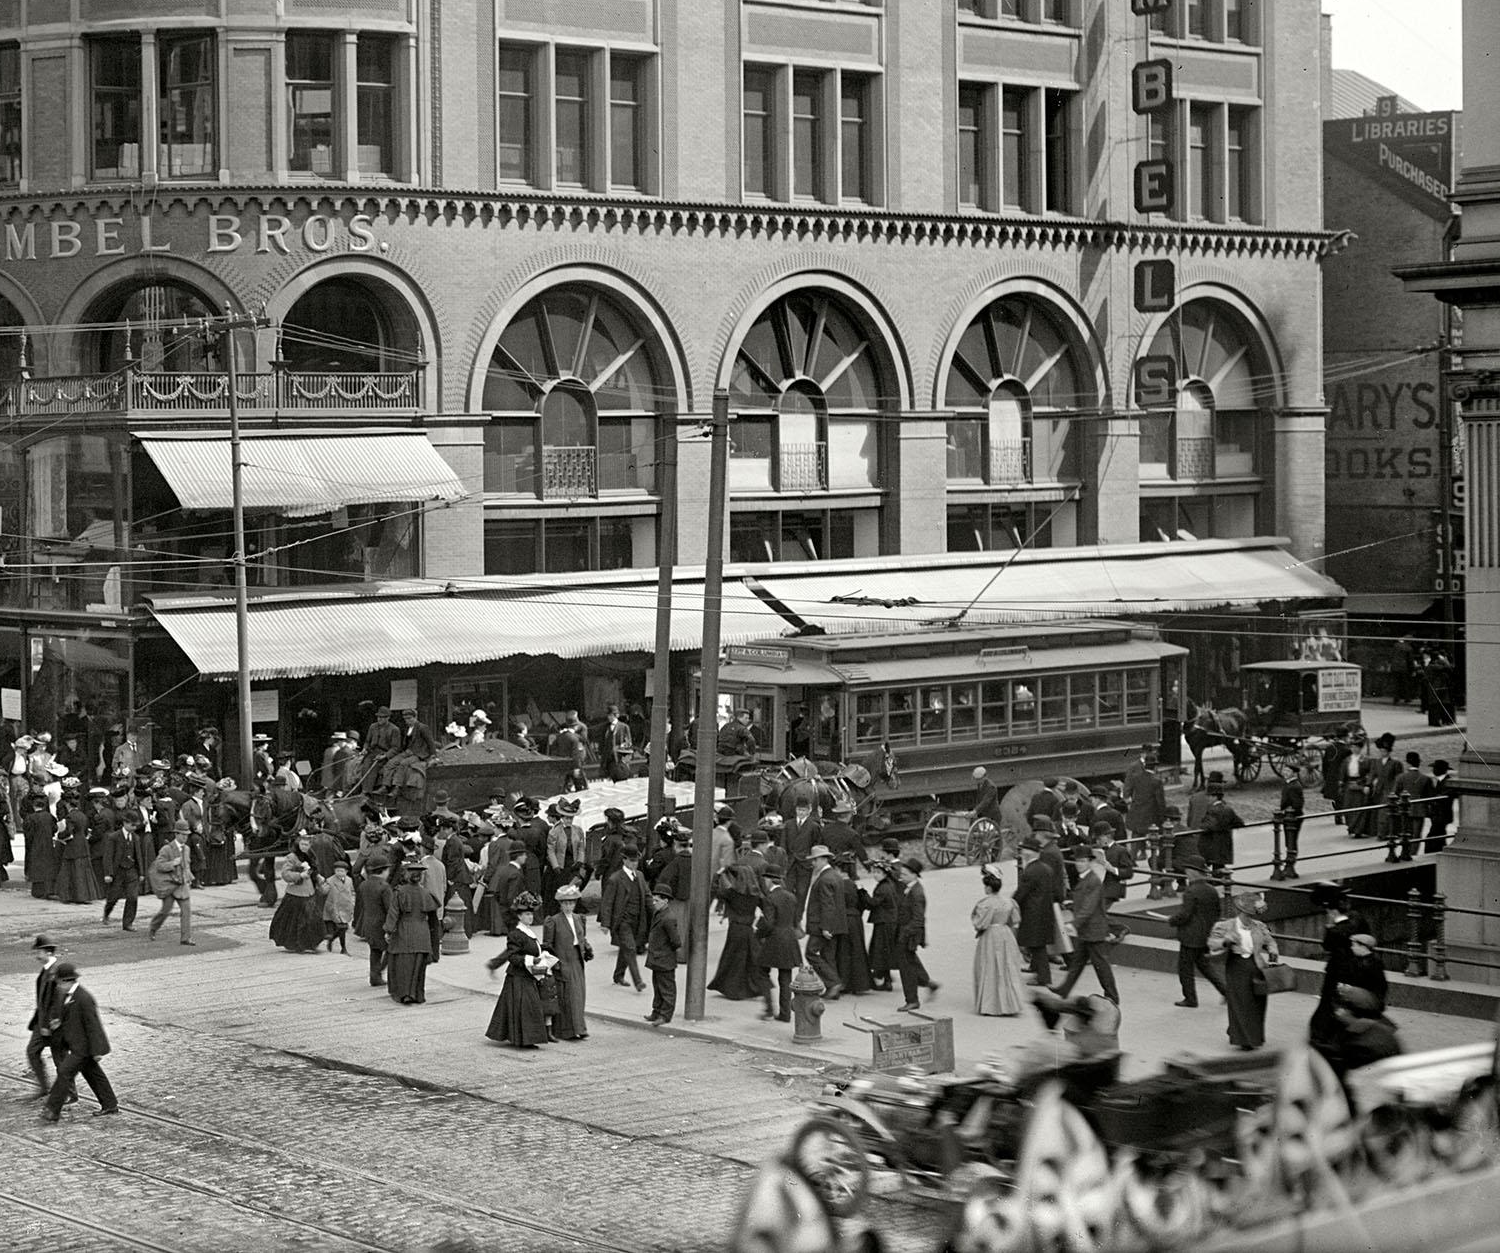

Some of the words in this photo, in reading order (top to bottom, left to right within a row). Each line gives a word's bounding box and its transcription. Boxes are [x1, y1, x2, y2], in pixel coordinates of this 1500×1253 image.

[1351, 117, 1449, 143] LIBRARIES
[1378, 142, 1449, 202] PURCHASED
[207, 213, 389, 254] BROS.
